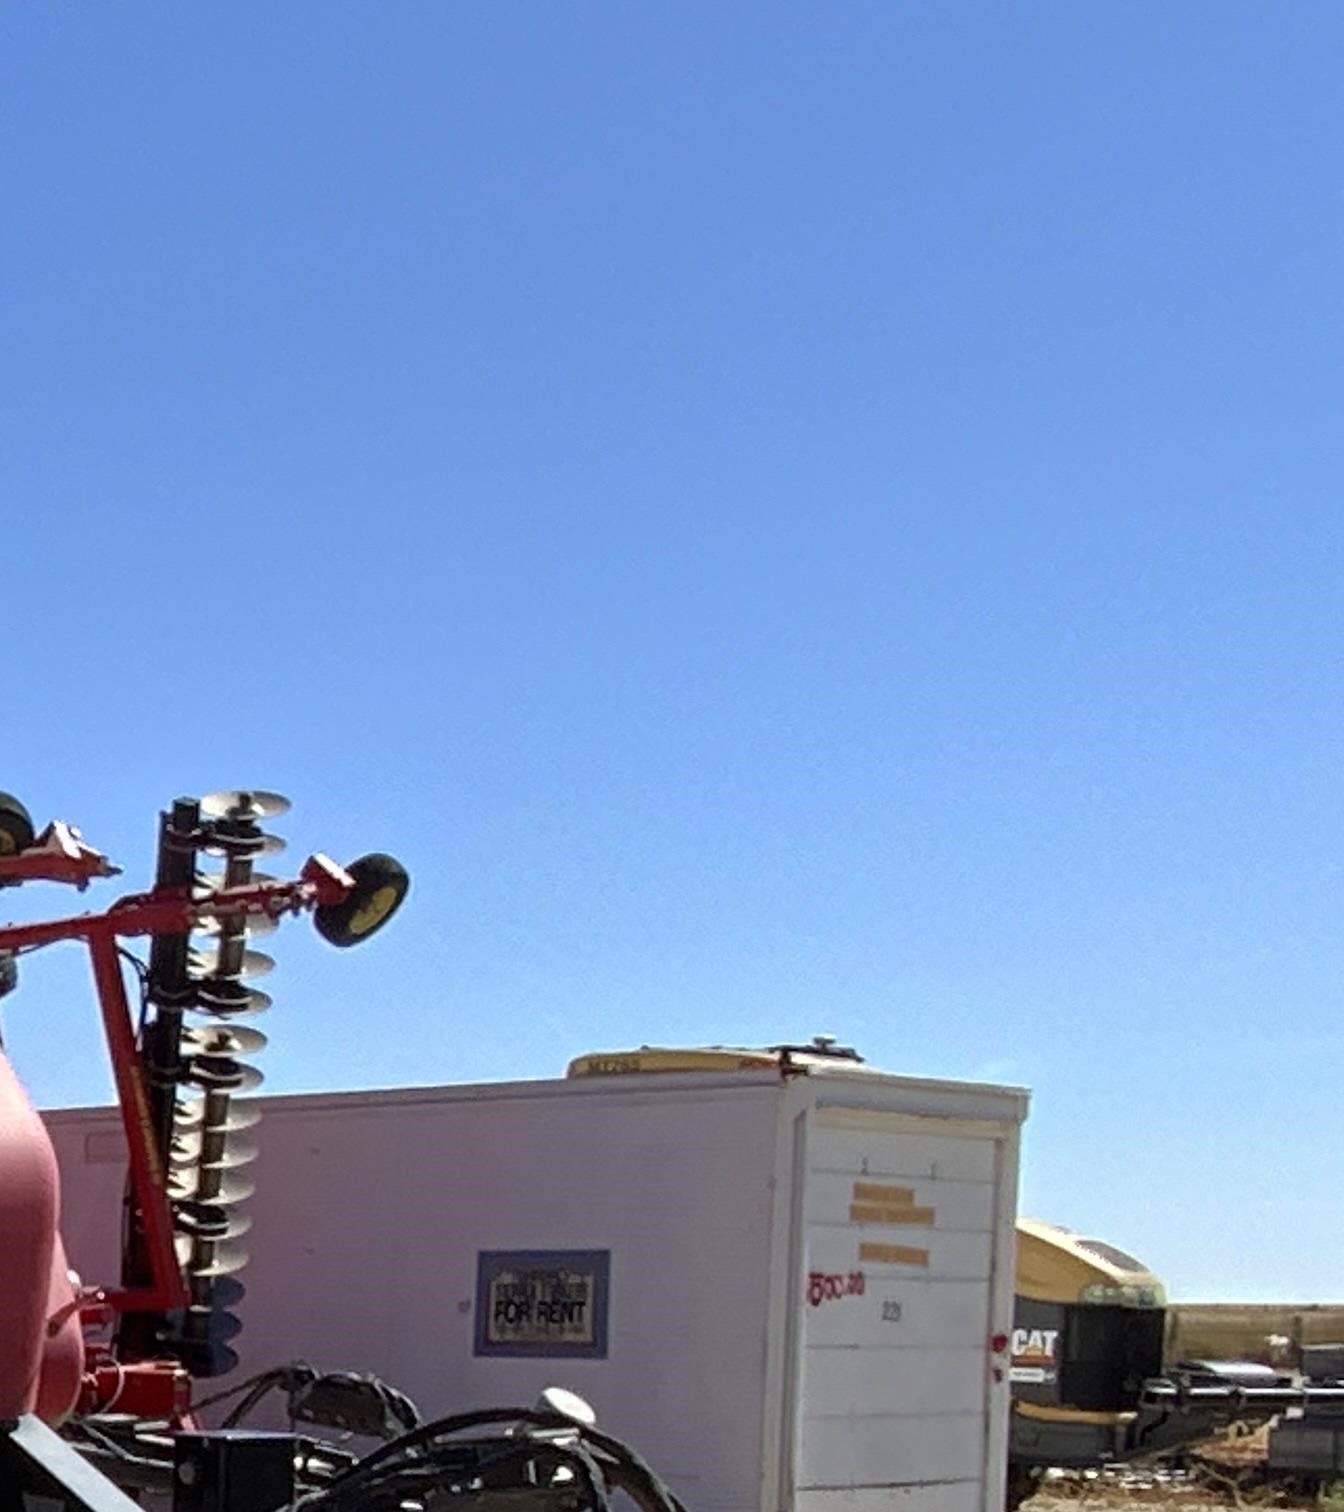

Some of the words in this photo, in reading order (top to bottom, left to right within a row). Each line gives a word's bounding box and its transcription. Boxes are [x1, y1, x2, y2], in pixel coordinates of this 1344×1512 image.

[495, 1299, 531, 1324] FOR
[537, 1300, 586, 1324] RENT
[1011, 1328, 1059, 1358] CAT
